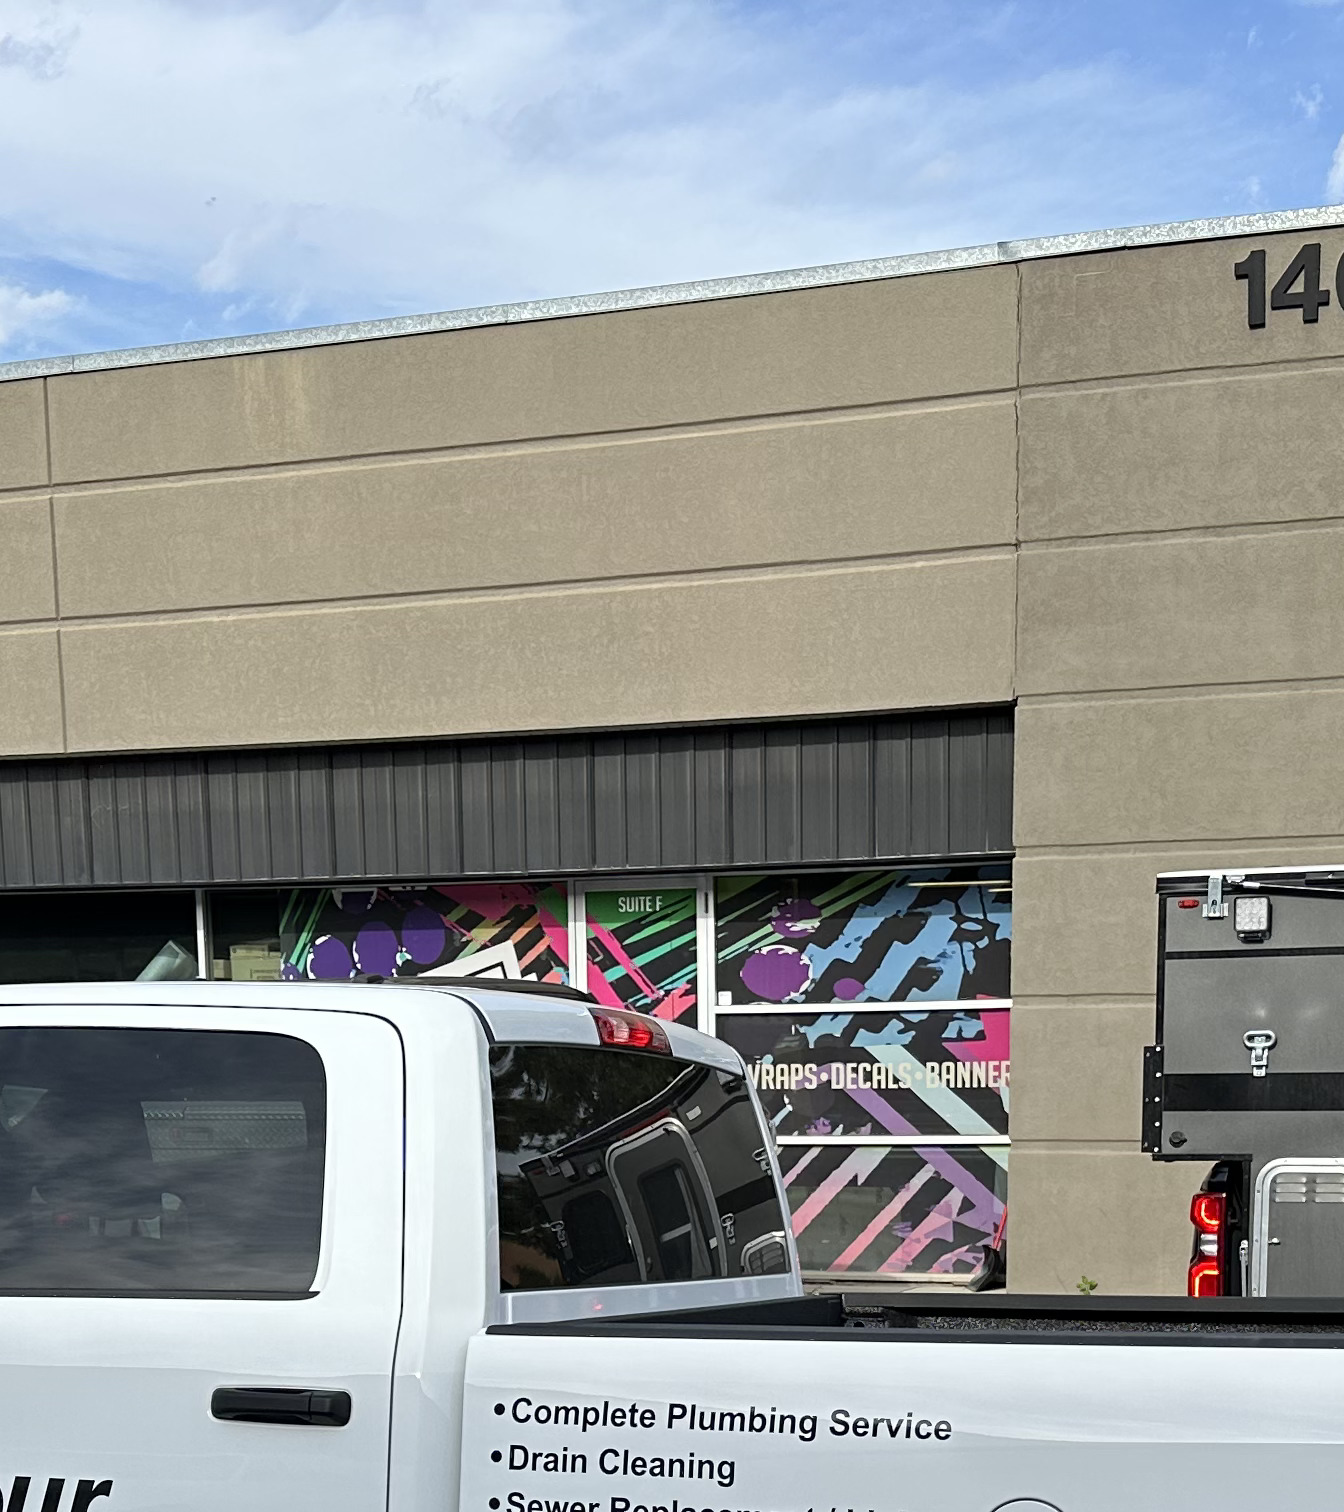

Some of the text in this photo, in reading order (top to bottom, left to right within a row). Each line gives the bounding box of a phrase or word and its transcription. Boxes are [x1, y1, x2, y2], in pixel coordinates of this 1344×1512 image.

[618, 896, 663, 912] SUITE F
[830, 1062, 912, 1089] DECALS
[511, 1398, 952, 1442] Complete Plumbing Service
[508, 1445, 735, 1488] Drain Cleaning
